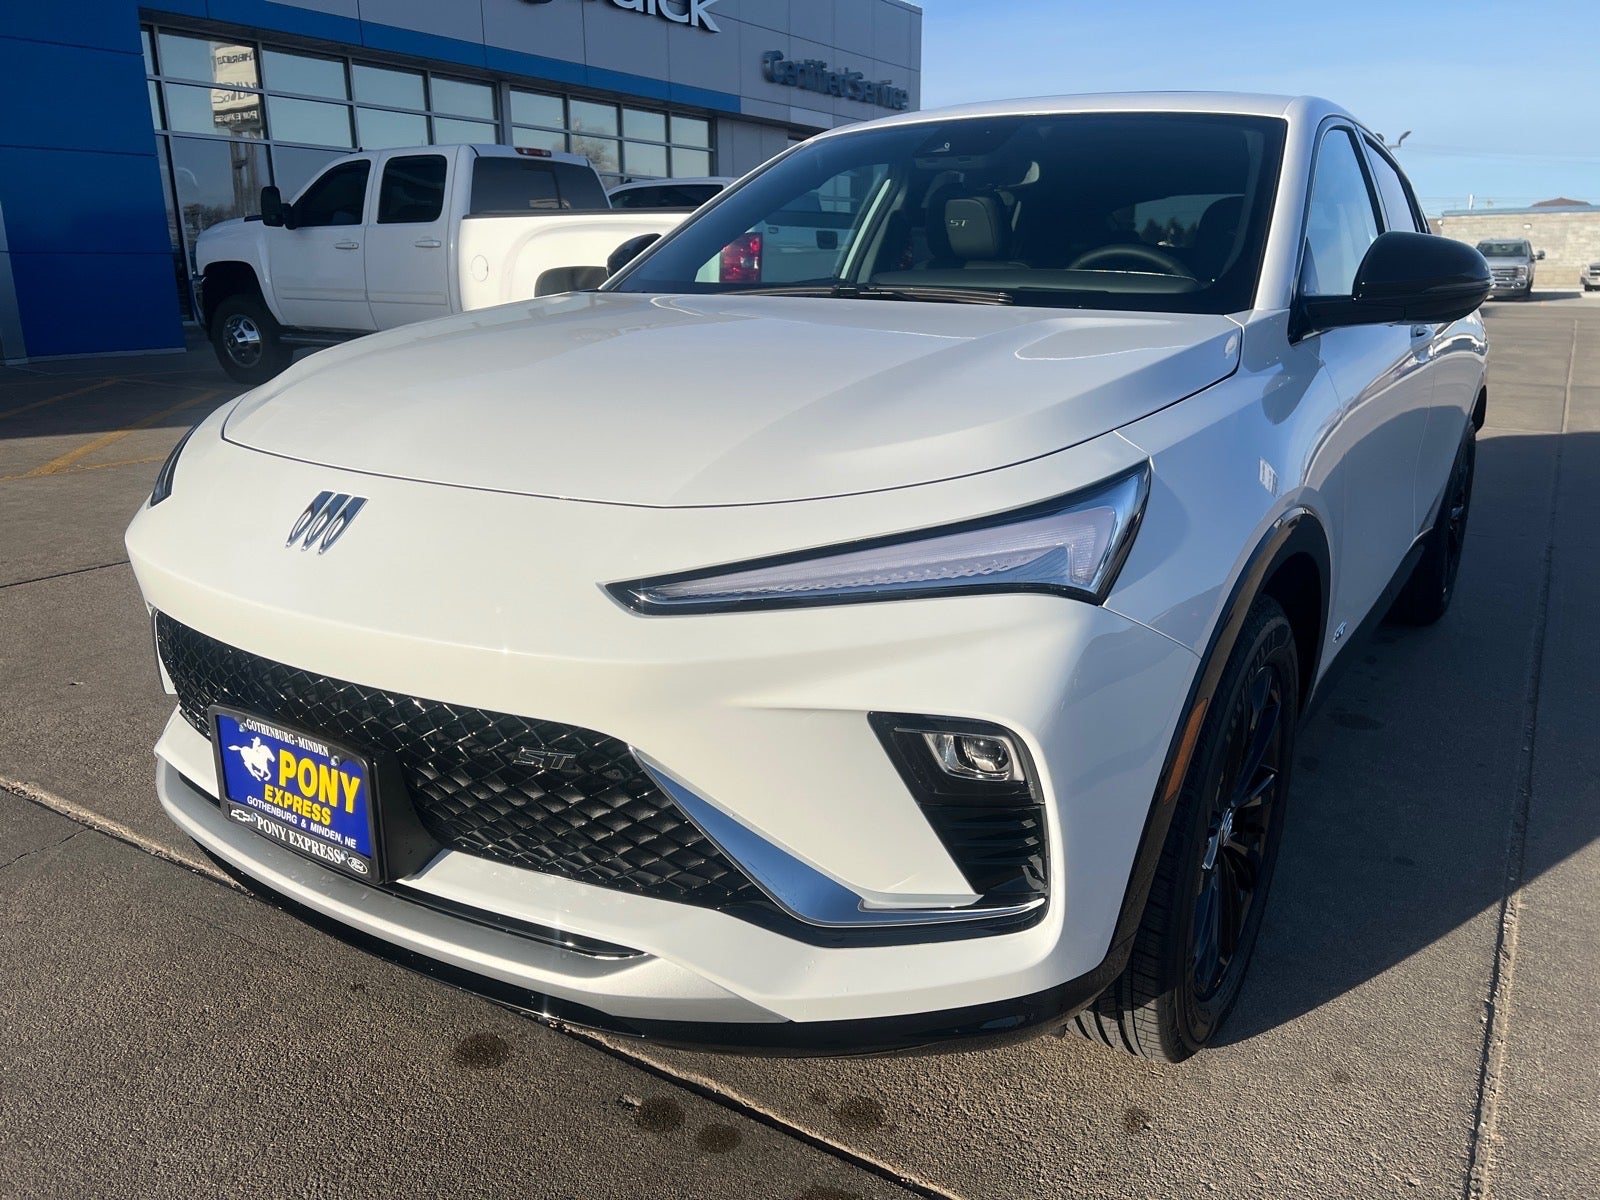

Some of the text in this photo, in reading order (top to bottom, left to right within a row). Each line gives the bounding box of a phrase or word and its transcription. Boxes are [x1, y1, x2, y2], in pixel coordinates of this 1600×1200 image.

[950, 219, 967, 227] ST
[512, 746, 576, 769] ST
[279, 749, 361, 814] PONY
[247, 796, 357, 849] GOTHENBURG & MINDEN, NE
[264, 784, 331, 826] EXPRESS
[256, 816, 342, 864] PONY EXPRESS
